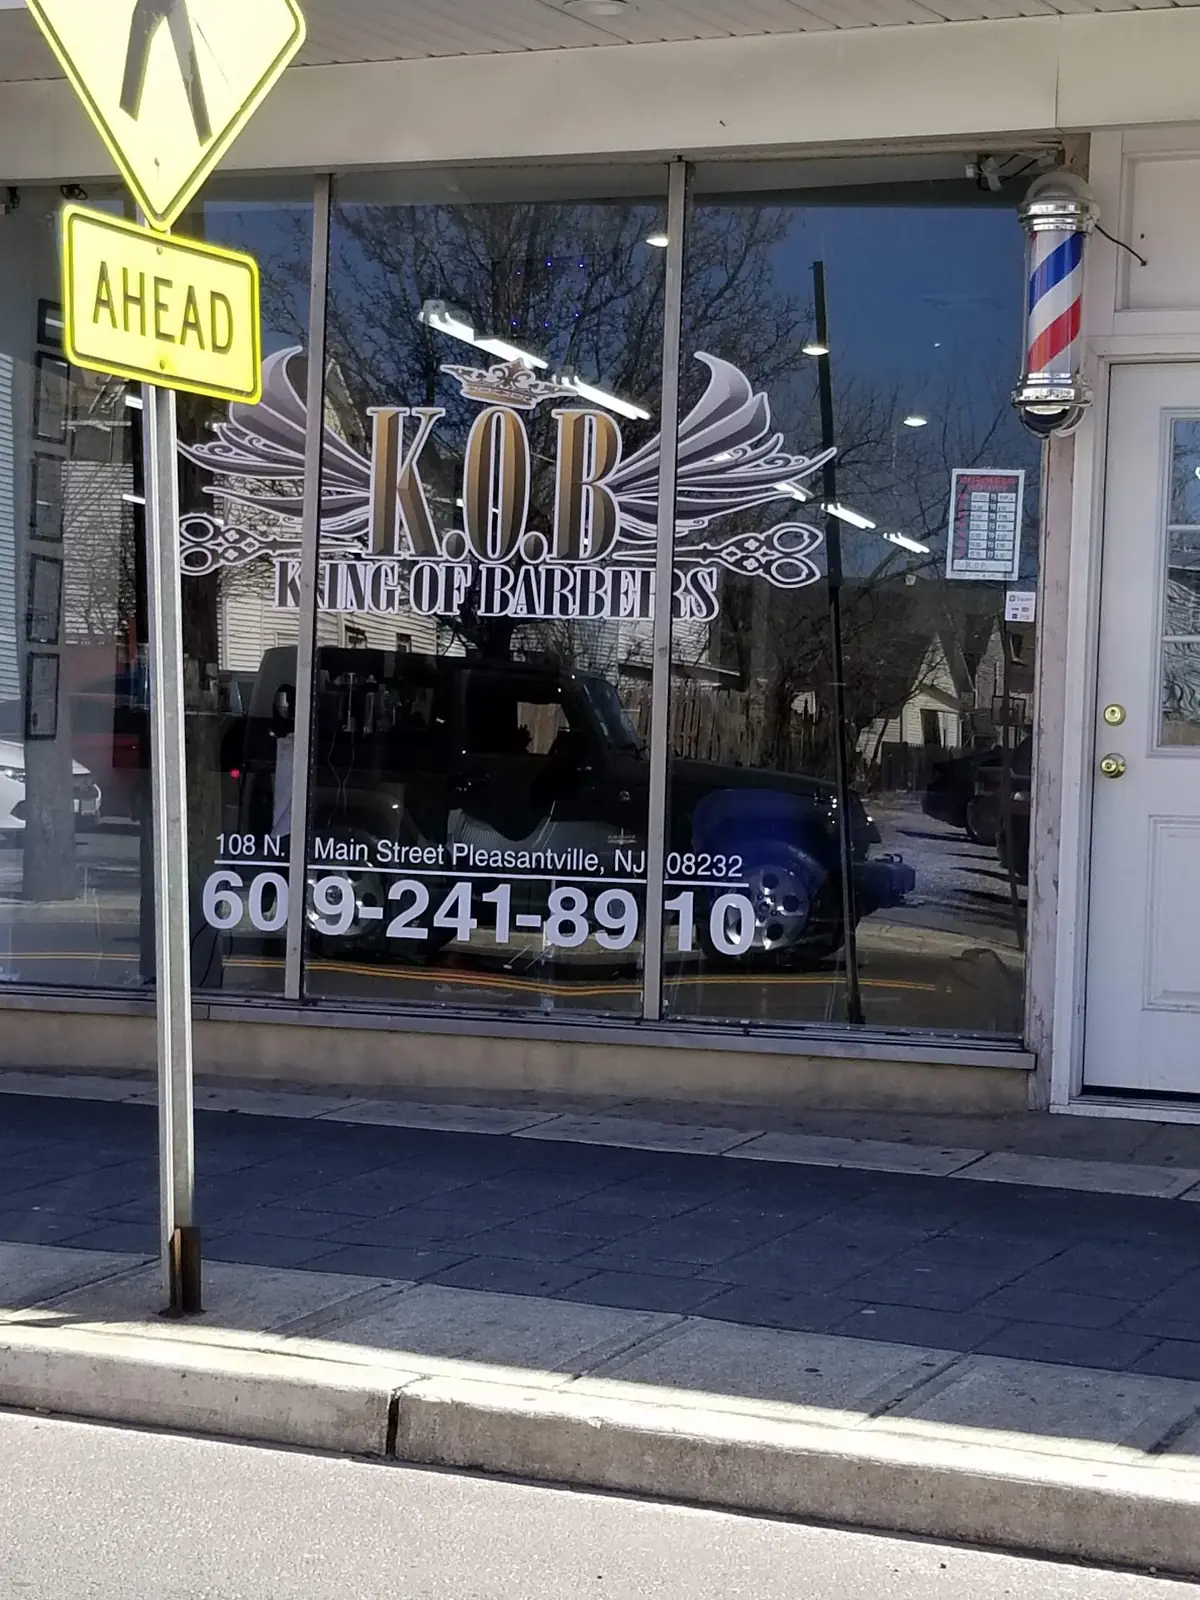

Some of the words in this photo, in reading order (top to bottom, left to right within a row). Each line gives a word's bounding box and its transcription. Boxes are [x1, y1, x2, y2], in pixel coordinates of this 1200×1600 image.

[92, 260, 234, 355] AHEAD
[272, 558, 400, 615] KING
[409, 561, 472, 616] OF
[477, 563, 720, 622] BARBERS
[216, 833, 256, 857] 108
[263, 834, 285, 858] N.
[314, 836, 368, 862] Main
[376, 838, 444, 865] Street
[452, 843, 605, 876] Pleasantville,
[614, 849, 646, 874] NJ
[666, 852, 743, 878] 08232
[202, 869, 756, 956] 609-241-8910
